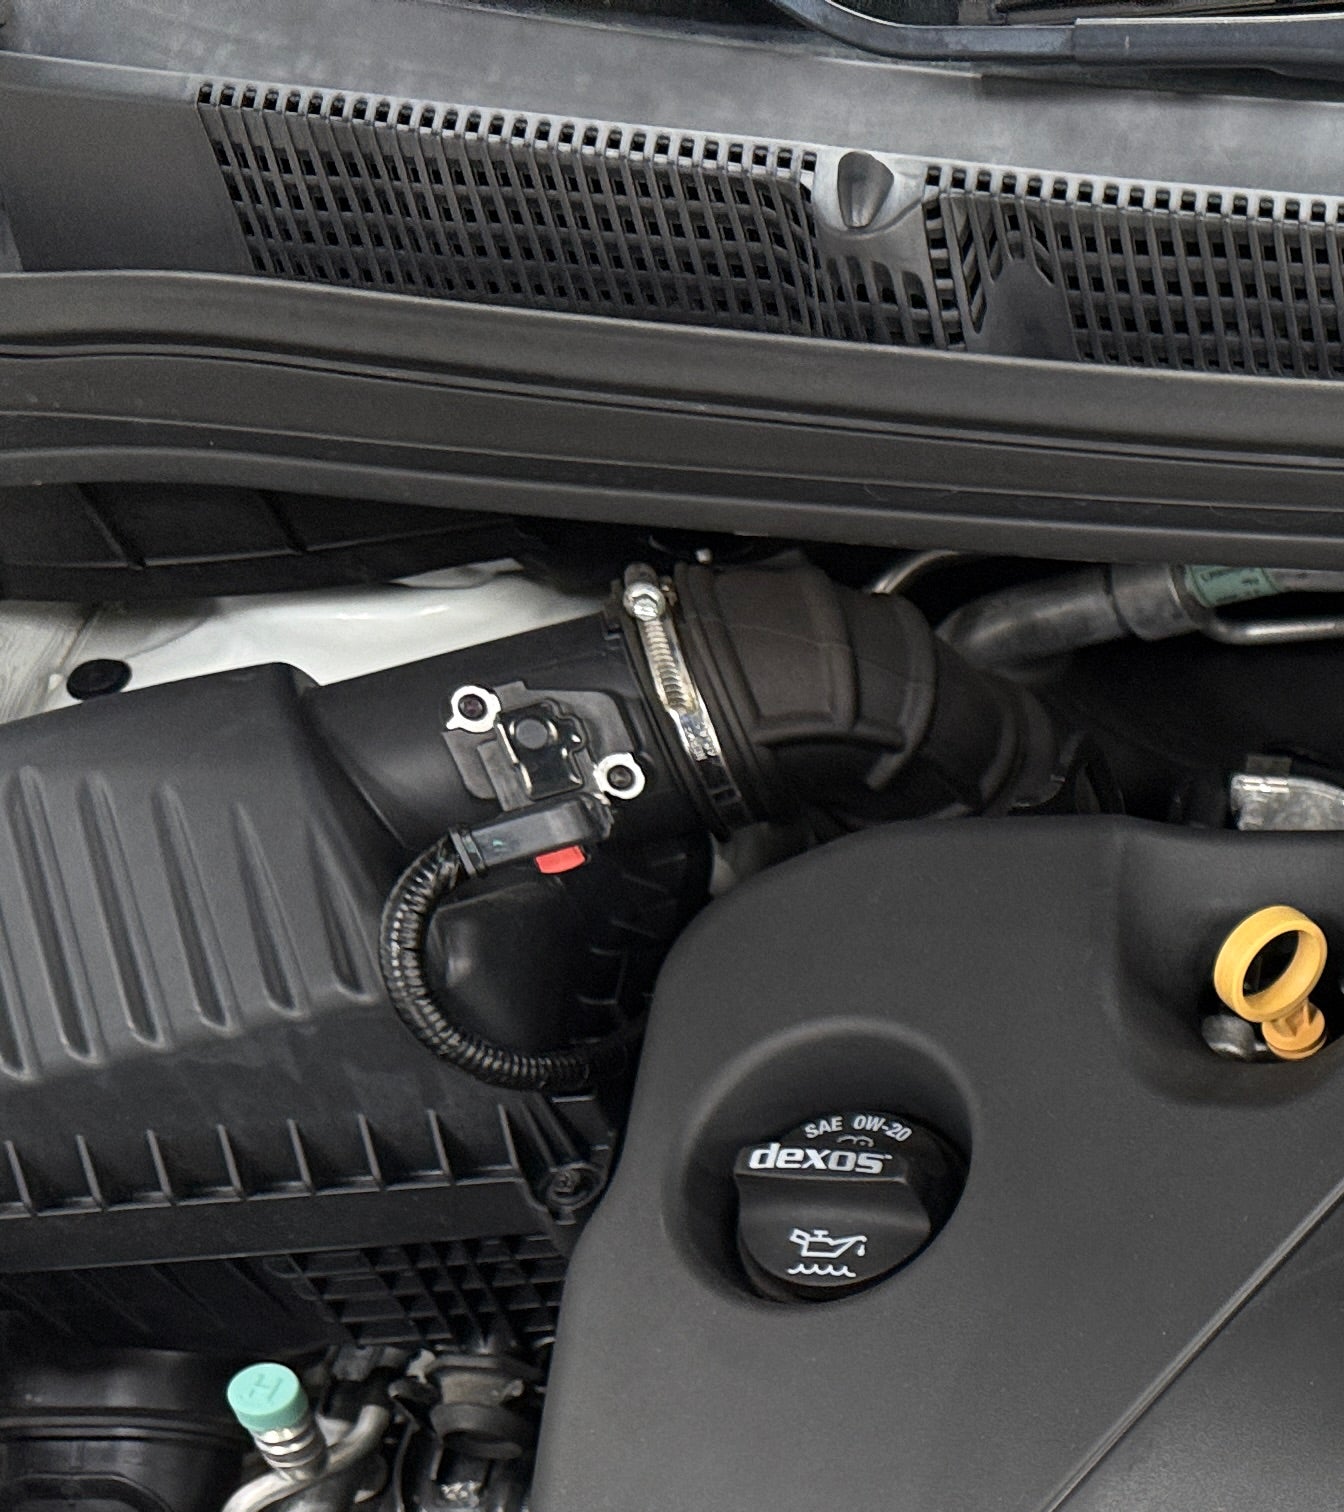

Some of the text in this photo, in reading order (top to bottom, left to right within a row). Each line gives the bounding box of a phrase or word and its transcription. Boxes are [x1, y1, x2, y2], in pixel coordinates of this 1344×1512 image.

[804, 1115, 912, 1143] SAE 0W-20
[749, 1142, 887, 1174] dexos
